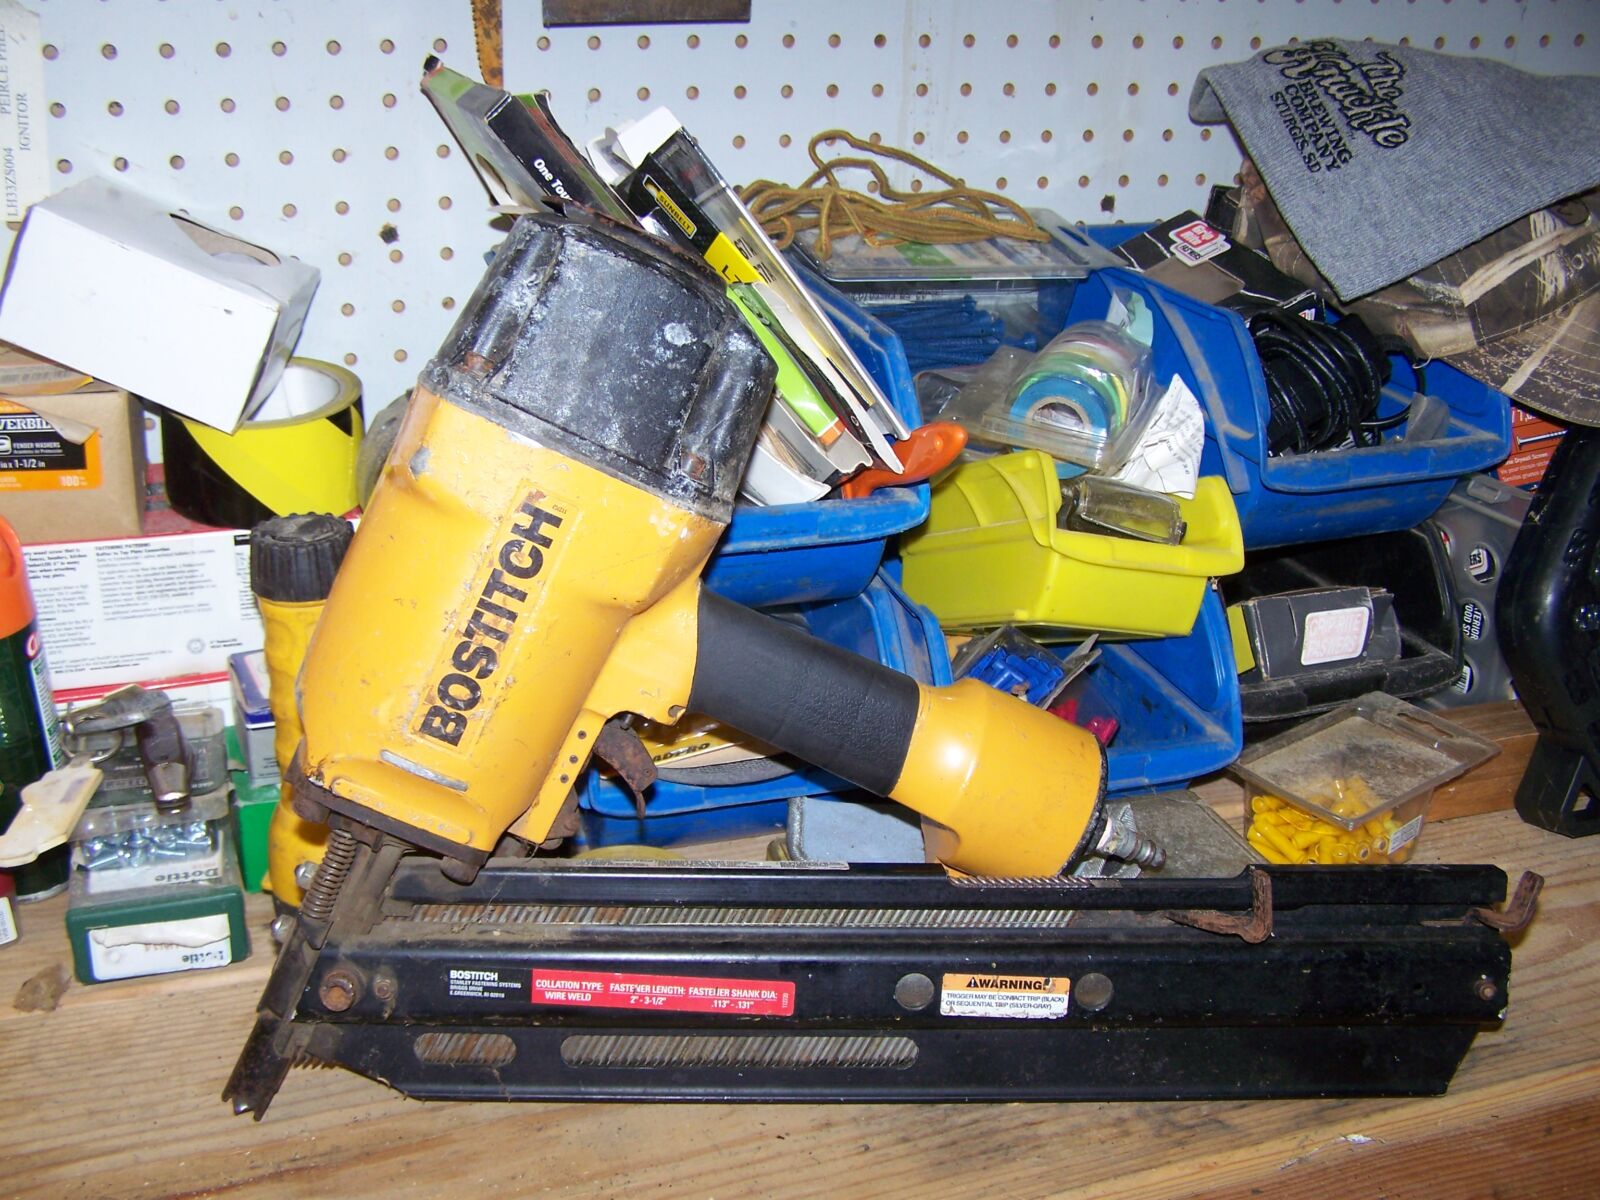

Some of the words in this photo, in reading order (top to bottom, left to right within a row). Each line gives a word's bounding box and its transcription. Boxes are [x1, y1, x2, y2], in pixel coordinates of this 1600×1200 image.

[1359, 52, 1406, 101] The
[1264, 41, 1411, 148] Knuckle
[16, 92, 31, 151] IGNITOR
[1284, 84, 1341, 171] COMPANY
[1298, 79, 1353, 163] BREWING
[533, 158, 554, 181] One
[658, 195, 691, 231] SUNBELT
[14, 459, 37, 468] 1-1/2
[419, 502, 563, 747] BOSTITCH
[1463, 603, 1473, 624] OOD
[1470, 607, 1482, 641] TERIOR
[155, 867, 219, 883] Dottie
[450, 970, 498, 981] BOSTITCH
[536, 979, 581, 989] COLLATION
[582, 981, 604, 991] TYPE:
[545, 991, 566, 1000] WIRE
[567, 992, 591, 1001] WELD
[609, 983, 650, 994] FASTENER
[652, 985, 686, 995] LENGTH:
[731, 988, 760, 998] SHANK
[761, 989, 778, 999] DIA:
[955, 1000, 994, 1008] SEQUENTIAL
